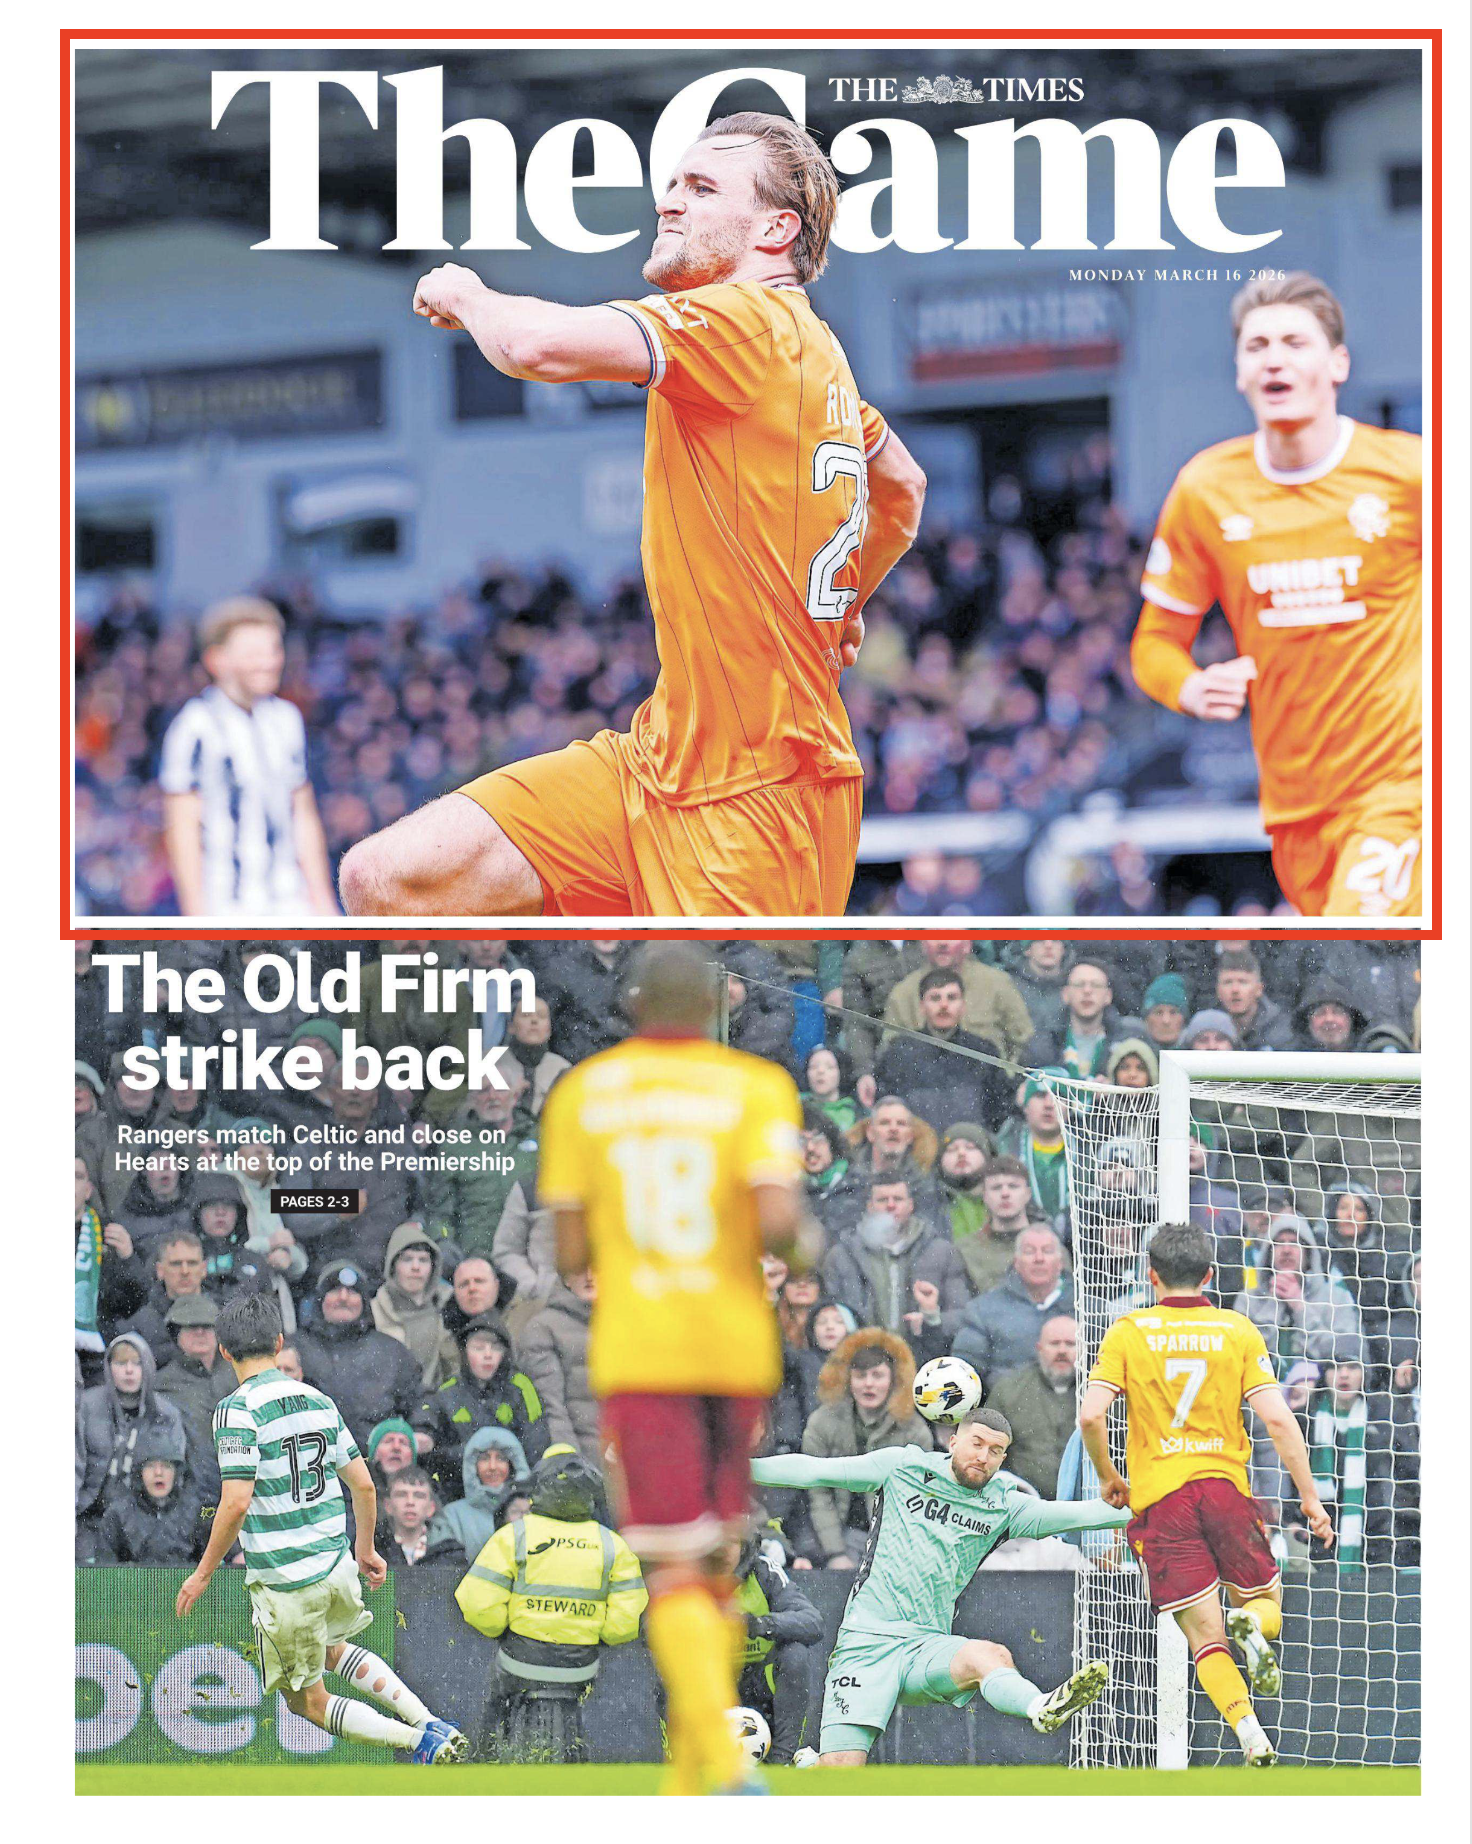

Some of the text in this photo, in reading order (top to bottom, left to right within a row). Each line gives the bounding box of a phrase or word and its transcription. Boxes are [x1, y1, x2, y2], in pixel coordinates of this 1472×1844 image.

[828, 77, 1085, 102] THE TIMES
[1069, 269, 1287, 281] MONDAY MARCH 16 2026
[1346, 836, 1420, 901] 20
[91, 951, 536, 1014] The Old Firm
[122, 1028, 323, 1091] strike
[342, 1028, 511, 1091] back
[118, 1124, 506, 1149] Rangers match Celtic and close on
[115, 1150, 515, 1176] Hearts at the top of the Premiership
[280, 1195, 350, 1208] PAGES 2-3
[1146, 1334, 1224, 1352] SPARROW
[277, 1394, 309, 1414] YANG
[1164, 1357, 1207, 1429] 7
[1184, 1437, 1225, 1453] kwiff
[281, 1432, 329, 1504] 13
[923, 1498, 951, 1525] G4
[951, 1513, 992, 1536] CLAIMS
[556, 1538, 587, 1550] PSG
[526, 1598, 597, 1617] STEWARD
[831, 1676, 862, 1689] TCL
